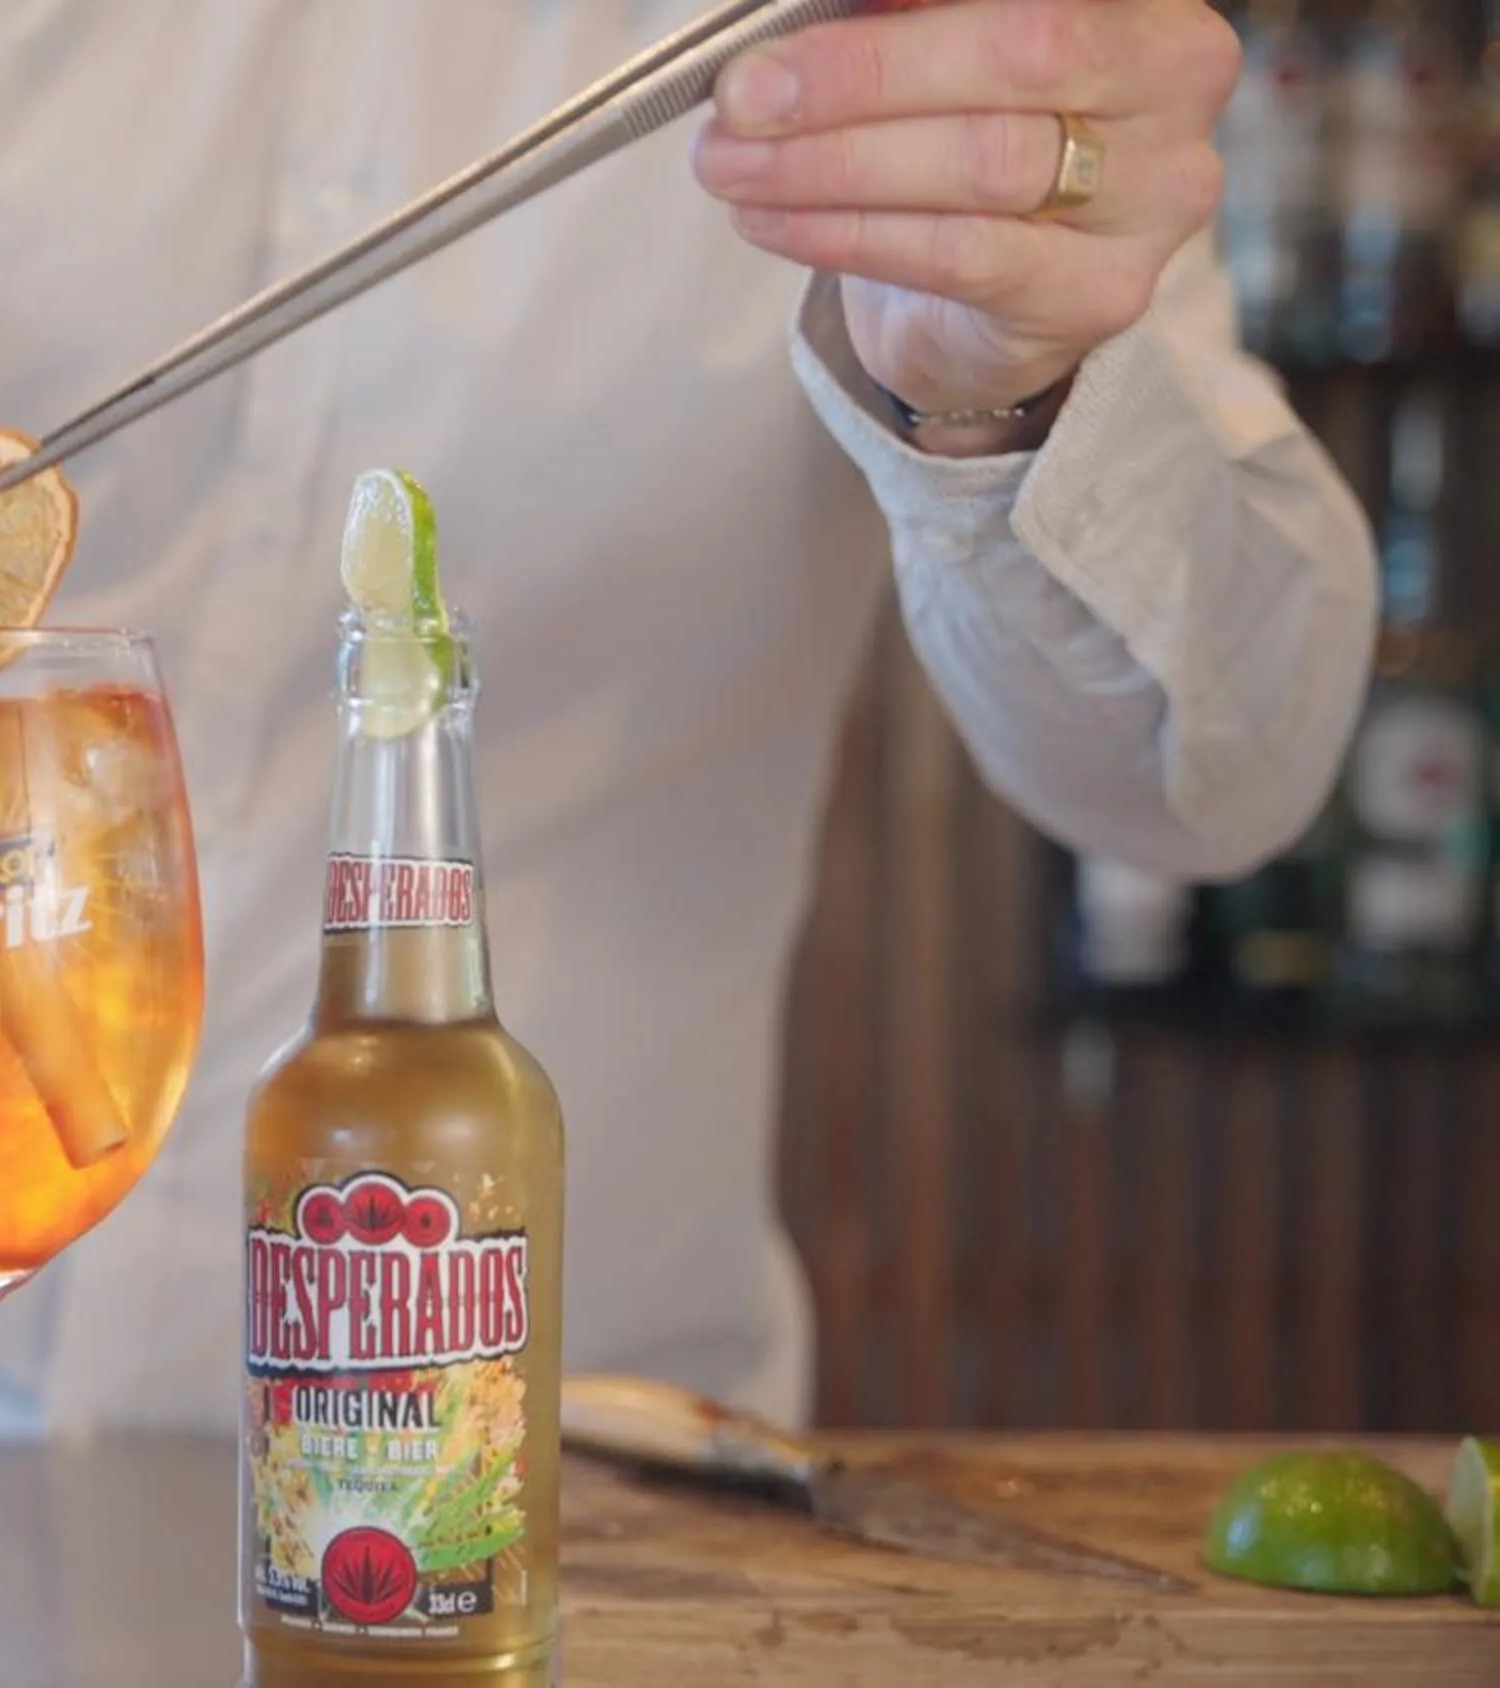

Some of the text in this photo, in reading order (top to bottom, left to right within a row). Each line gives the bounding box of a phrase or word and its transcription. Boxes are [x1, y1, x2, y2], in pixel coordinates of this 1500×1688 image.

[248, 1239, 525, 1361] DESPERADOS
[294, 1386, 441, 1428] ORIGINAL
[387, 1438, 437, 1462] BIER
